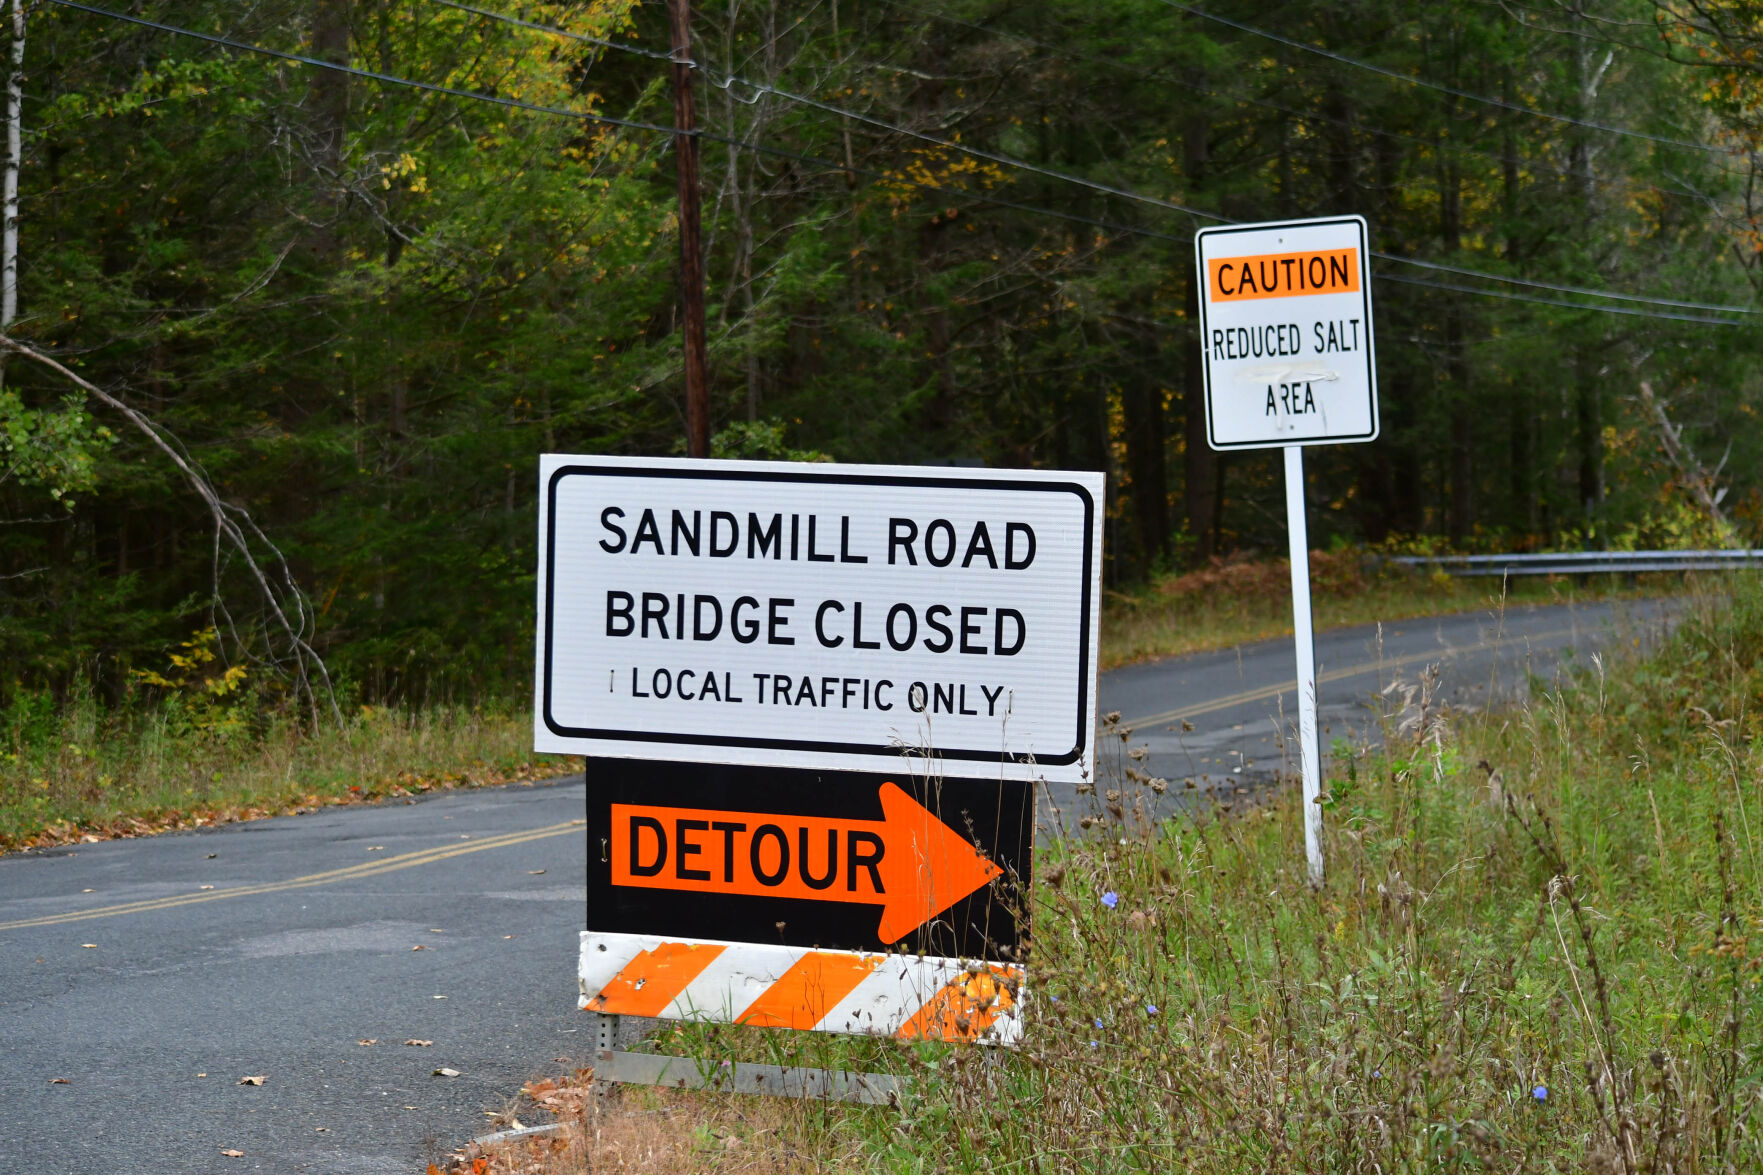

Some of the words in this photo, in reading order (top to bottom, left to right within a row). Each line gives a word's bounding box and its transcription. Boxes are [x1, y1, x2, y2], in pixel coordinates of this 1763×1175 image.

[1218, 254, 1349, 295] CAUTION
[1213, 323, 1301, 360] REDUCED
[1314, 319, 1359, 353] SALT
[1266, 382, 1316, 416] AREA
[598, 506, 868, 564] SANDMILL
[888, 517, 1037, 570] ROAD
[606, 590, 795, 645] BRIDGE
[815, 599, 1026, 656] CLOSED
[631, 667, 742, 703] LOCAL
[753, 673, 894, 711] TRAFFIC
[907, 680, 1004, 717] ONLY
[629, 815, 886, 894] DETOUR
